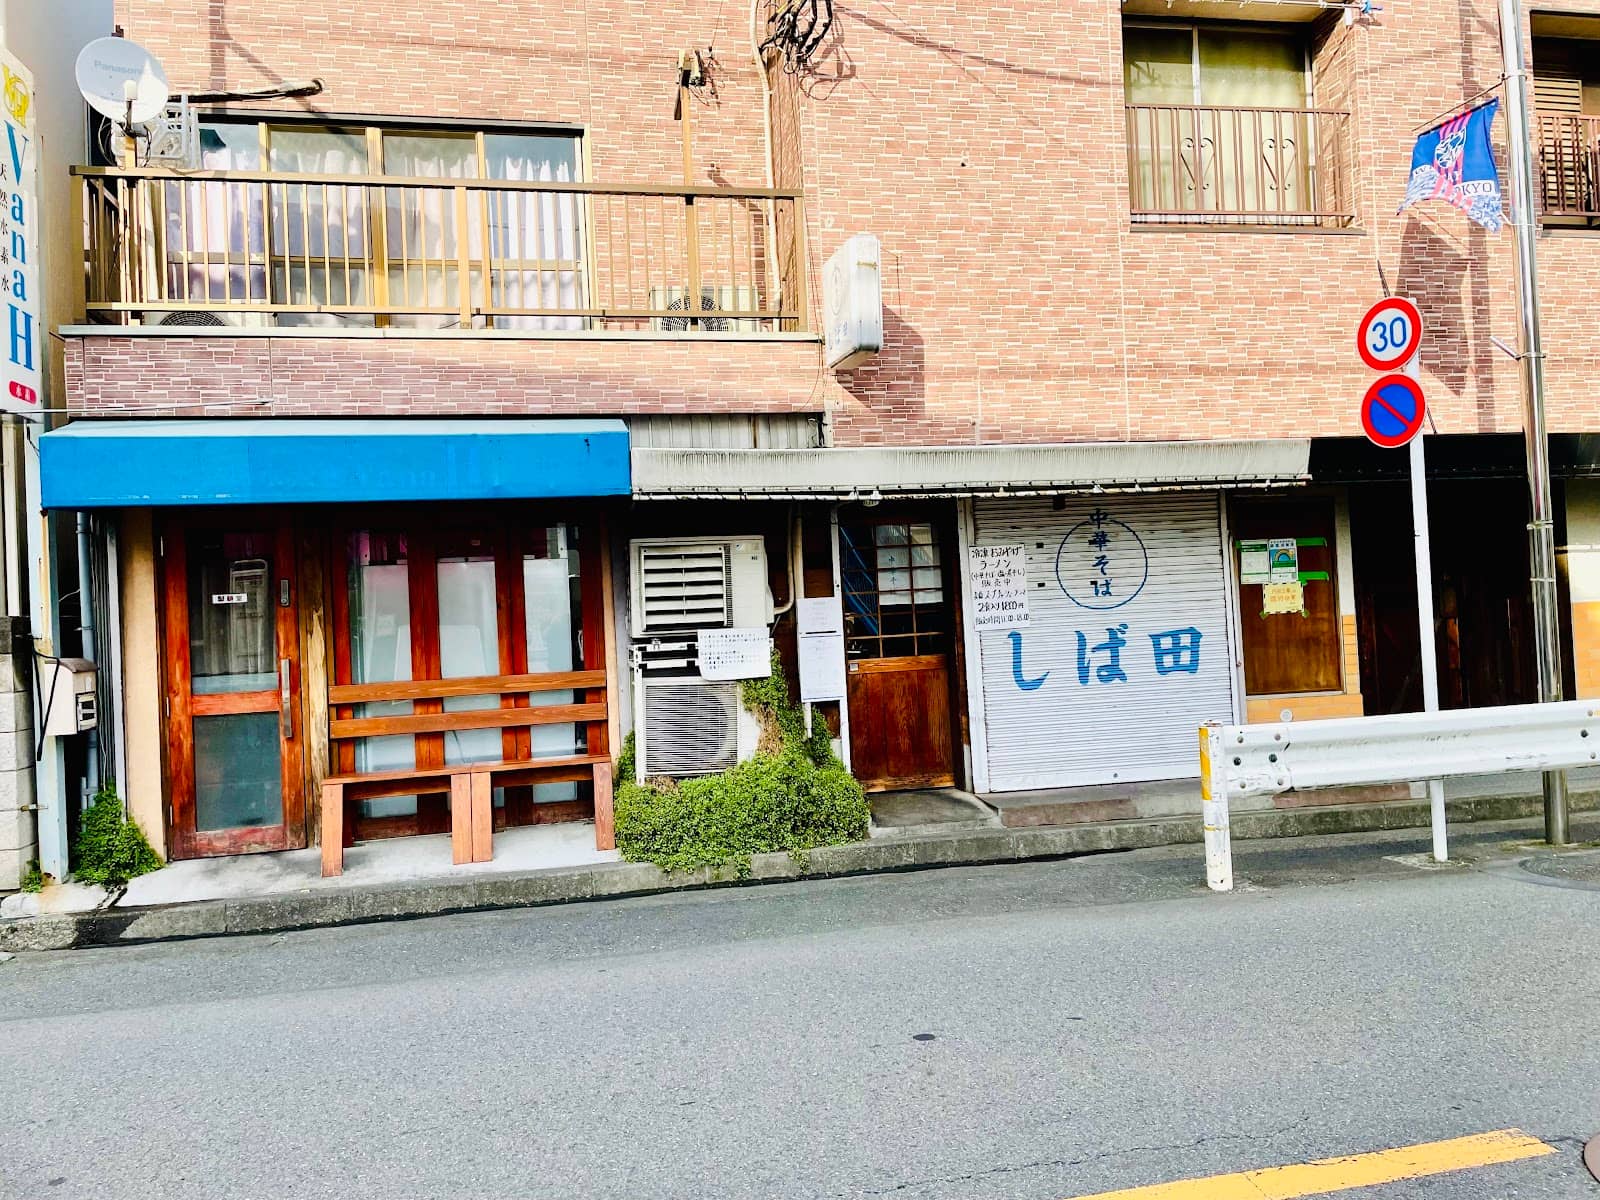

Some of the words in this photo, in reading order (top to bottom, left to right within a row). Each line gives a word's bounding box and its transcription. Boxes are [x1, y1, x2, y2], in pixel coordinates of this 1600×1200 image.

[4, 119, 35, 372] VanaH
[1371, 315, 1407, 353] 30
[1087, 508, 1113, 598] 中華そば
[1007, 623, 1204, 691] しば田
